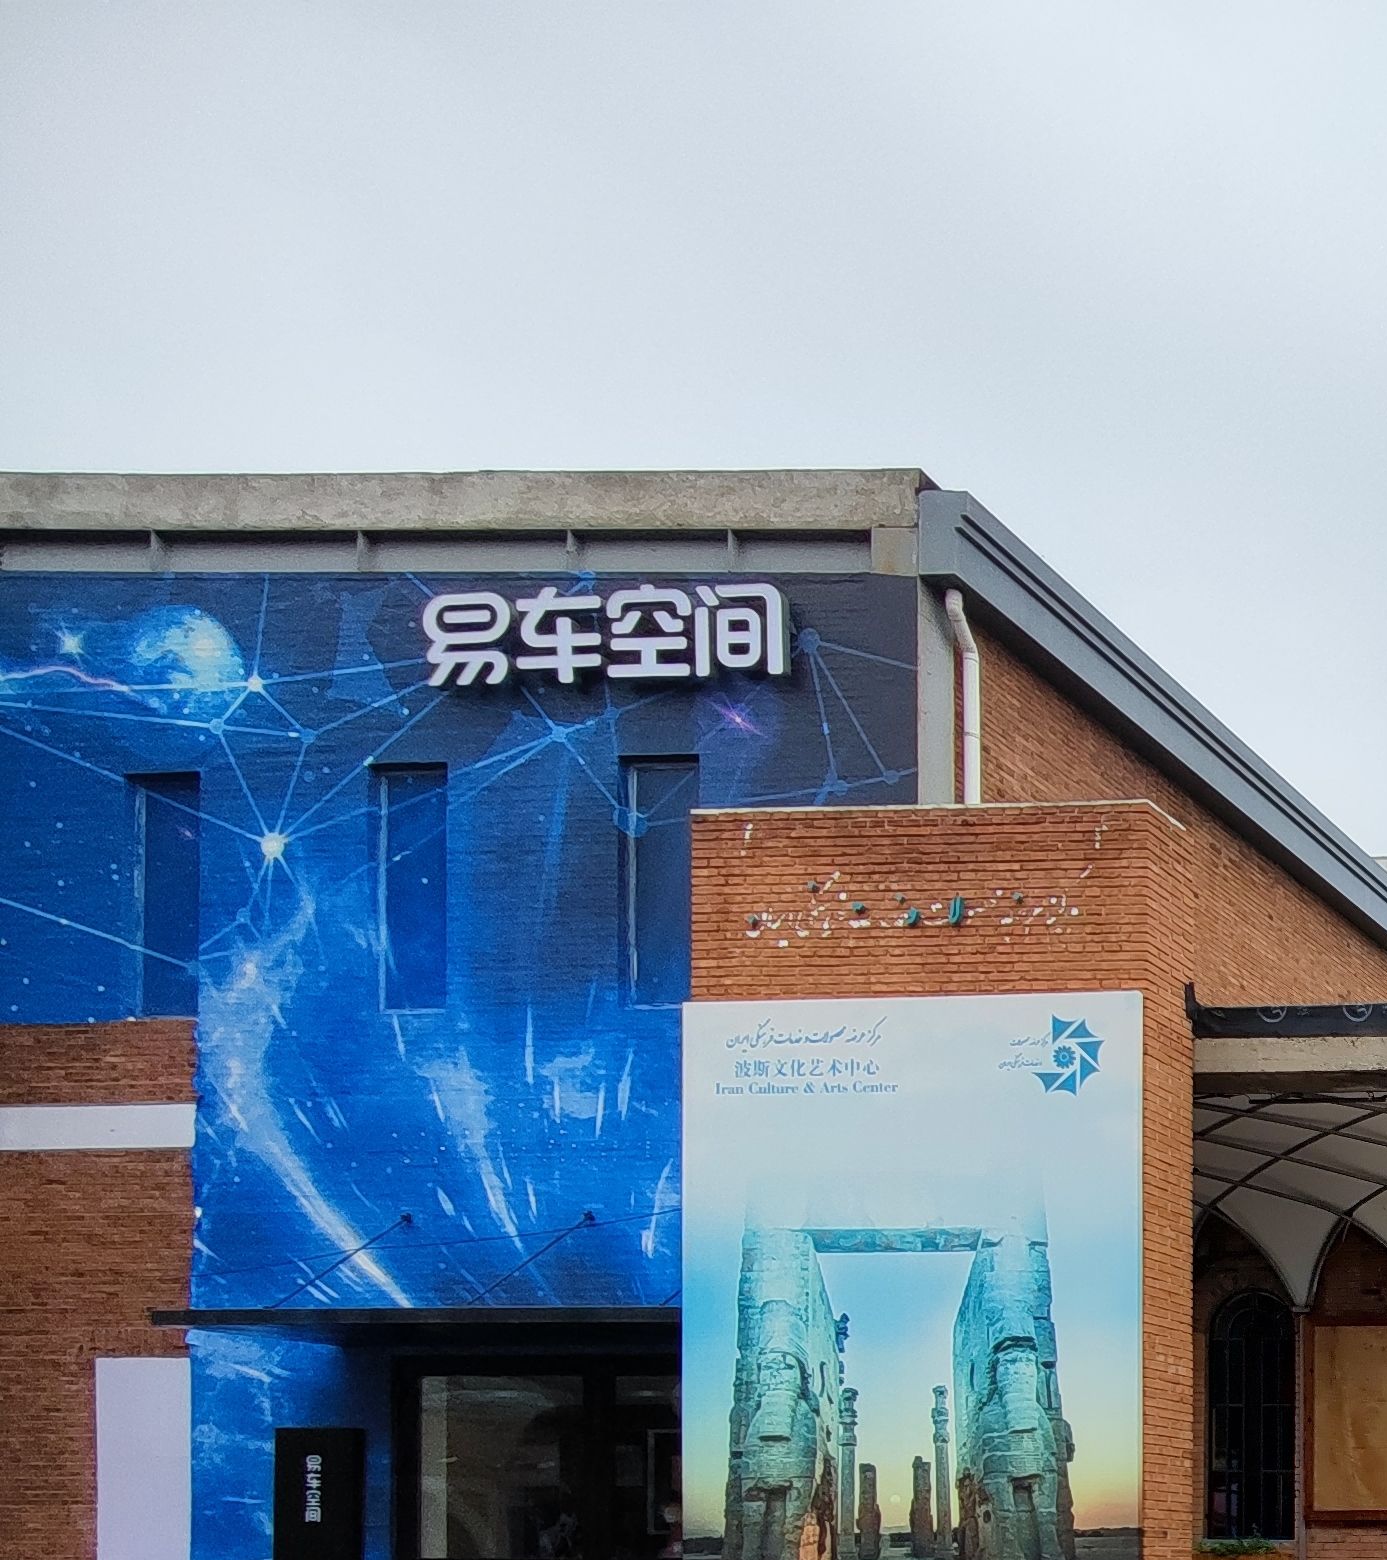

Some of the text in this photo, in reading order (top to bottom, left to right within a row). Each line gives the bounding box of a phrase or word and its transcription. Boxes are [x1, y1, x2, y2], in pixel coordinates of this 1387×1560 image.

[422, 583, 785, 687] 易车空间
[734, 1058, 880, 1079] 波斯文化艺术中心
[715, 1080, 899, 1095] Iran Culture & Arts Center
